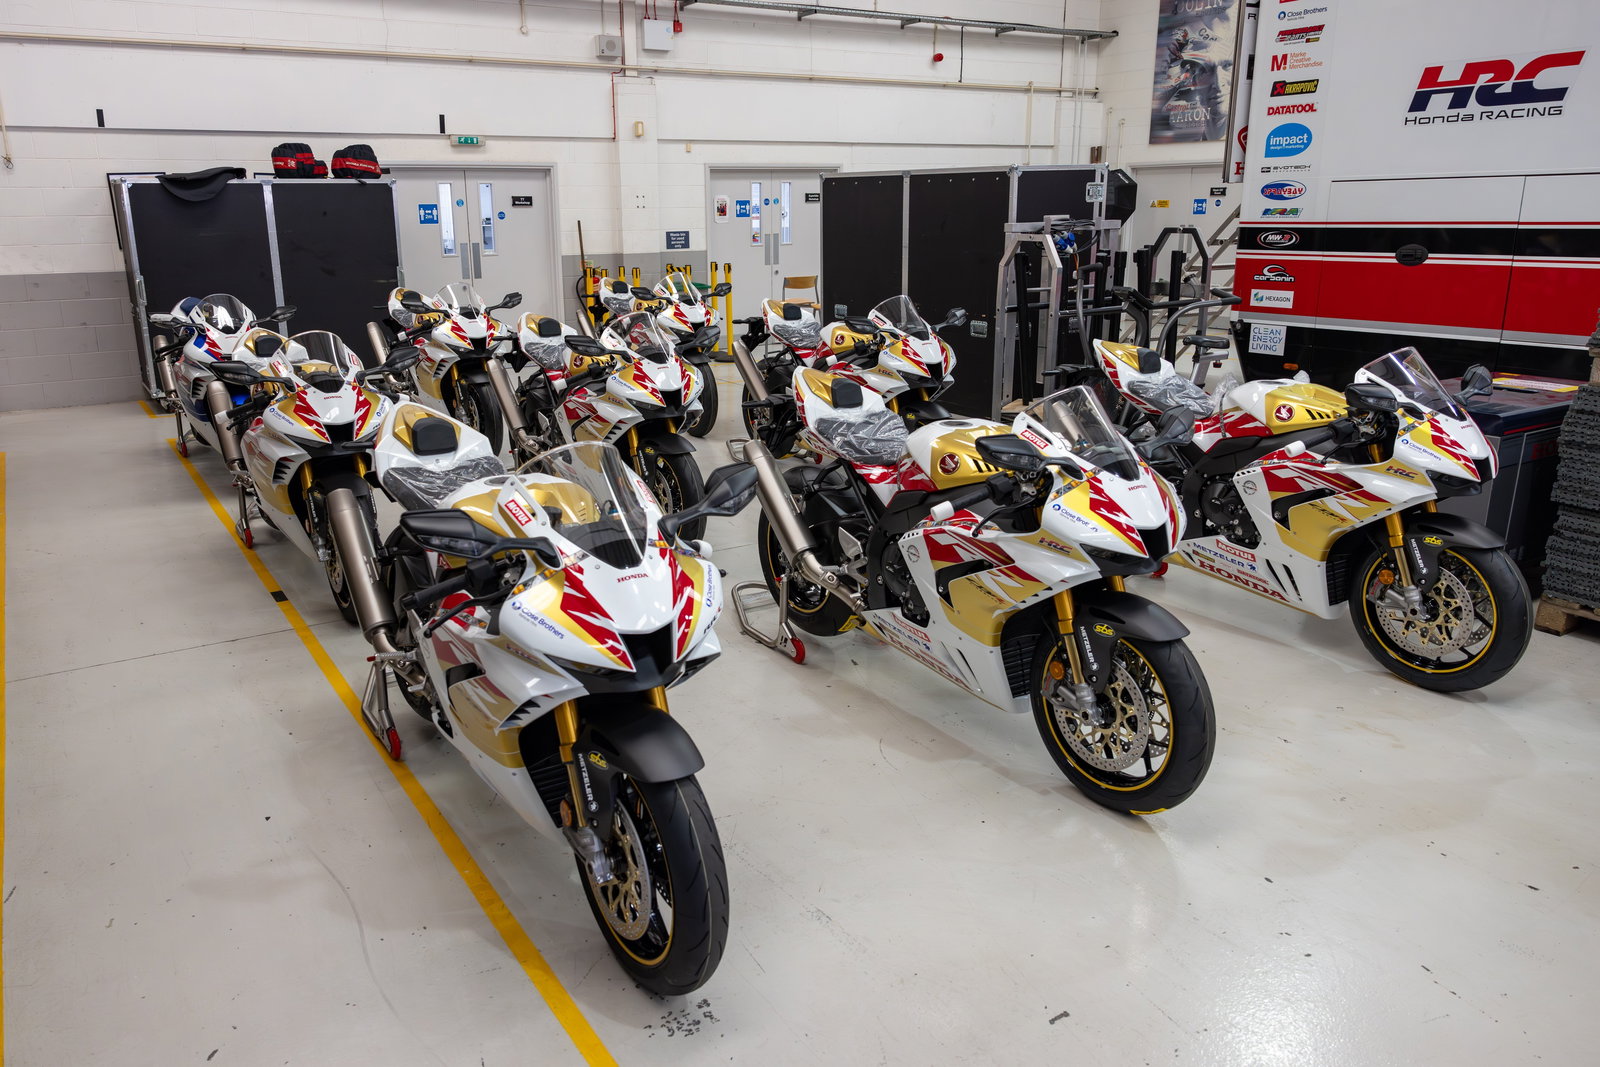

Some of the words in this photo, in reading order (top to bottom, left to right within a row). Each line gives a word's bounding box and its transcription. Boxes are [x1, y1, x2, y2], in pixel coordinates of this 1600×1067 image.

[1287, 10, 1303, 18] Close
[1303, 6, 1328, 16] Brothers
[1289, 61, 1324, 70] Merchandise
[1407, 50, 1586, 113] HRC
[1267, 103, 1318, 116] DATATOOL
[1405, 112, 1475, 126] Honda
[1480, 106, 1564, 121] RACING
[1270, 133, 1308, 147] impact
[1263, 187, 1304, 196] SPRAYBAY
[1253, 274, 1295, 282] carbonin
[1265, 295, 1291, 303] HEXAGON
[1252, 326, 1282, 336] CLEAN
[1252, 335, 1283, 345] ENERGY
[1251, 343, 1277, 352] LIVING
[1021, 430, 1048, 449] MOTUL
[1409, 441, 1423, 452] Close
[1421, 447, 1442, 462] Brothers
[505, 499, 532, 526] MOTUL
[1061, 507, 1077, 520] Close
[1423, 536, 1443, 546] sbs
[1193, 542, 1245, 569] METZELER
[1217, 540, 1256, 562] MOTUL
[1410, 538, 1425, 568] METZELER
[616, 573, 650, 584] HONDA
[1197, 558, 1291, 604] HONDA
[521, 608, 540, 621] Close
[537, 618, 565, 640] Brothers
[1094, 624, 1115, 636] sbs
[1080, 626, 1095, 663] METZELER
[589, 753, 608, 769] sbs
[577, 753, 594, 801] METZELER
